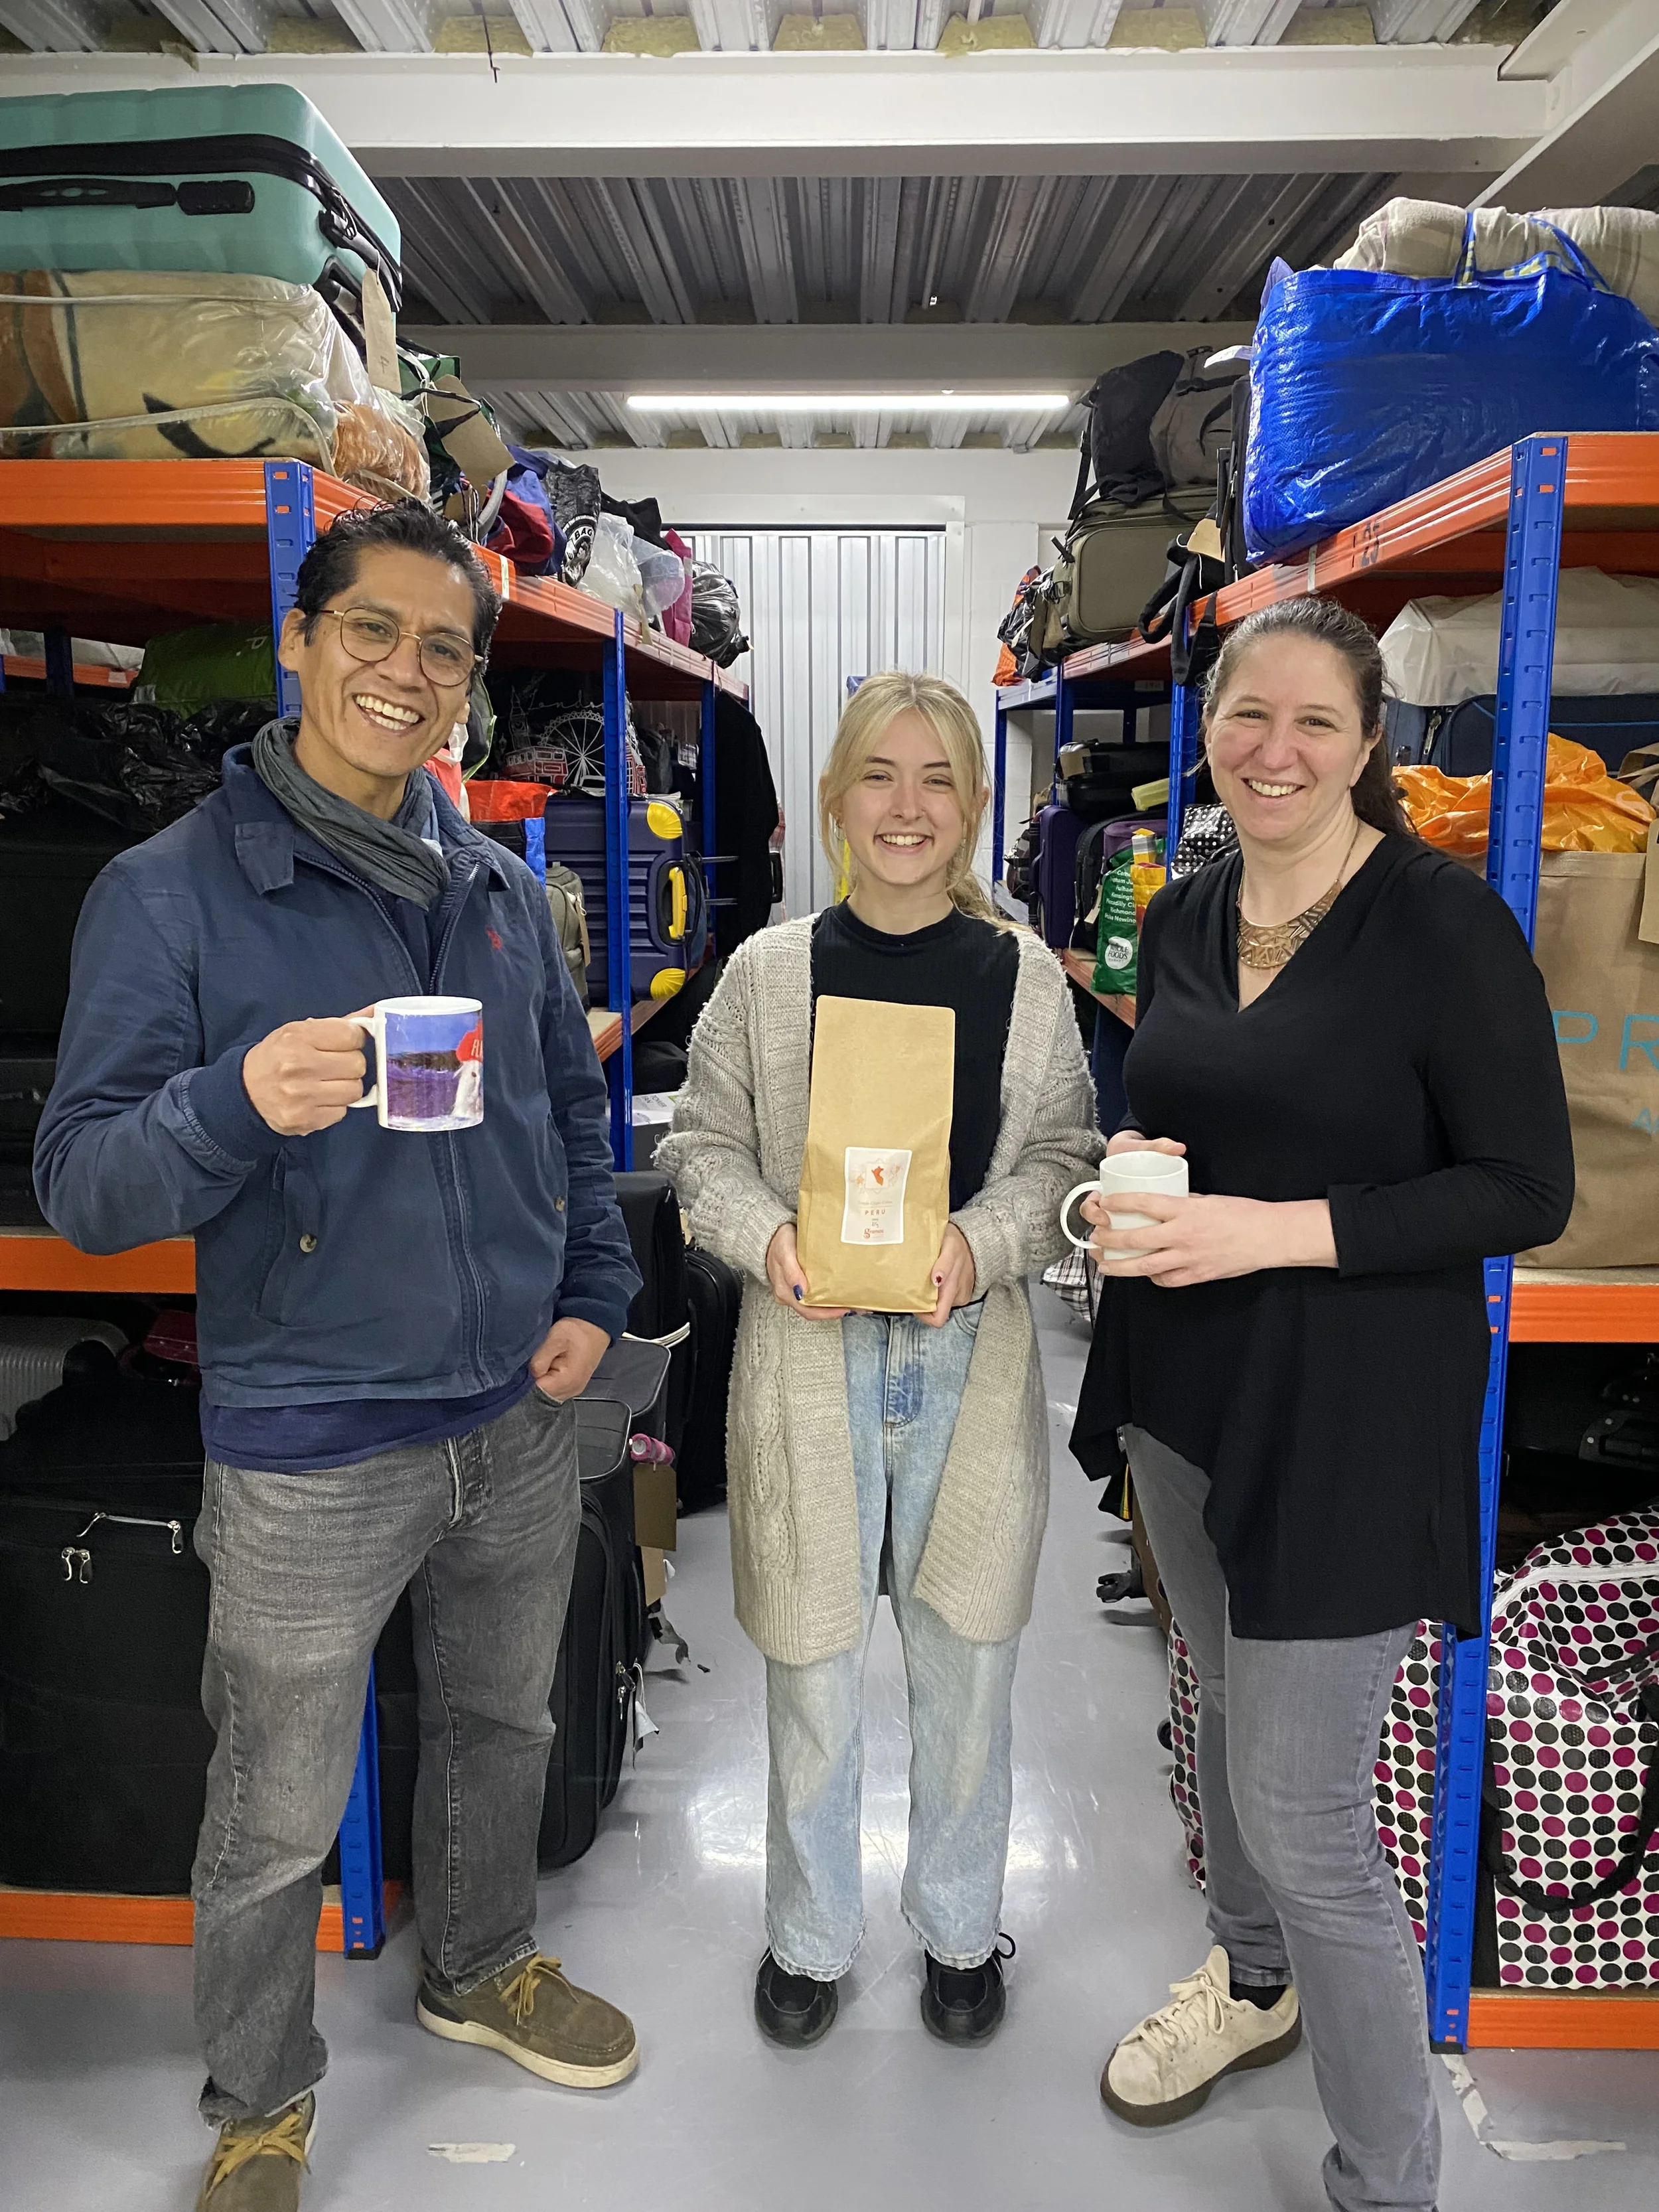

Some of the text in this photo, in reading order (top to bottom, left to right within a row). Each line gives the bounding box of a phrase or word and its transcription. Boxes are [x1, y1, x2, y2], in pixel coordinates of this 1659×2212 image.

[575, 528, 593, 540] BAG
[528, 688, 604, 710] Londo
[1108, 950, 1127, 959] FOODS
